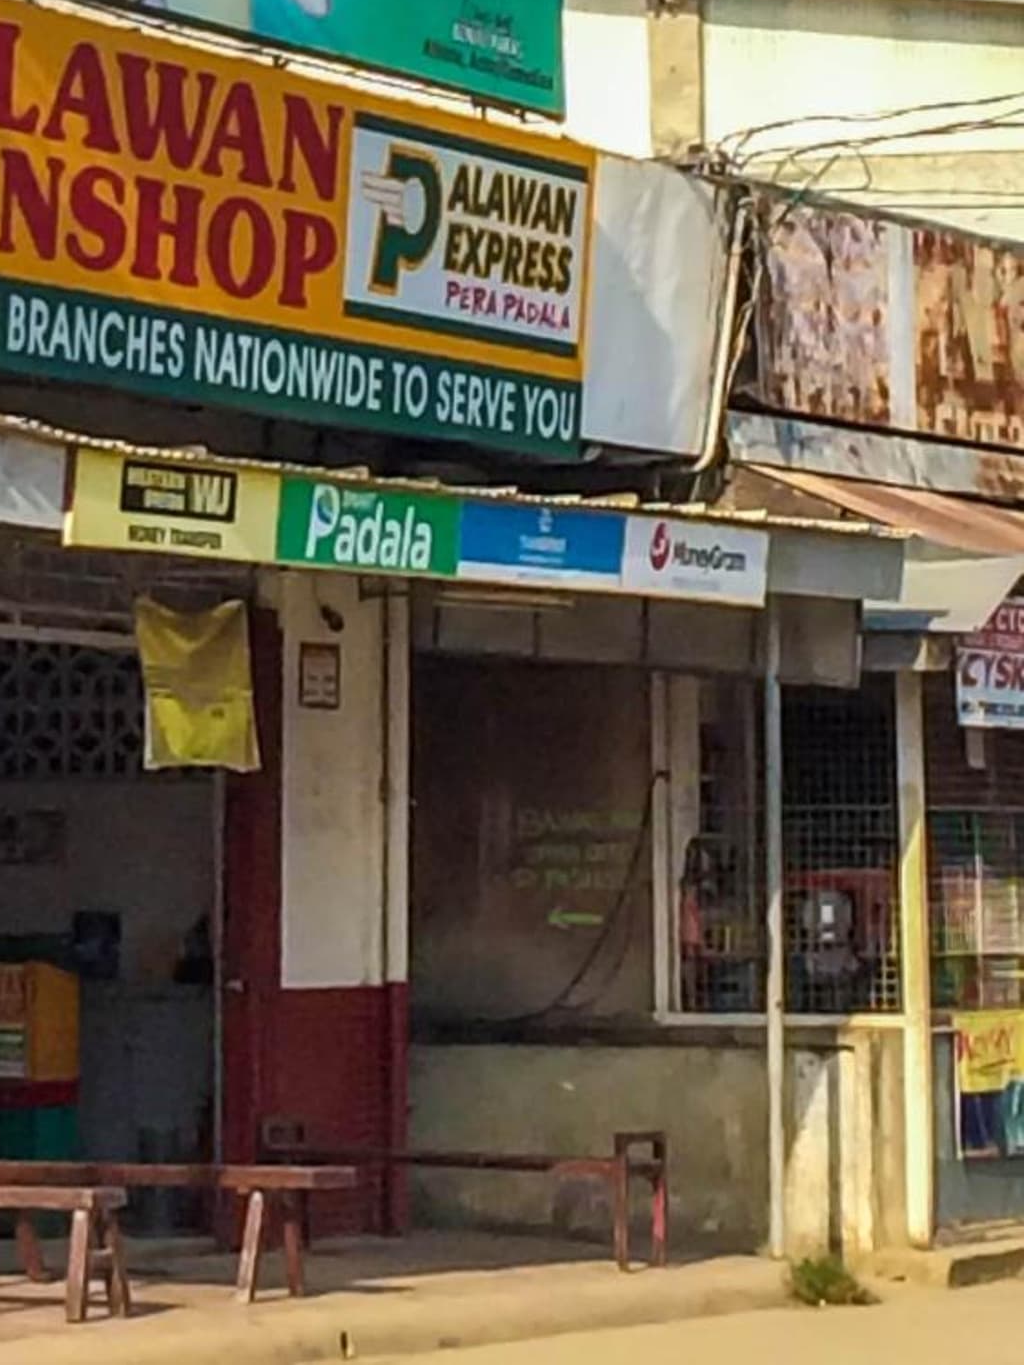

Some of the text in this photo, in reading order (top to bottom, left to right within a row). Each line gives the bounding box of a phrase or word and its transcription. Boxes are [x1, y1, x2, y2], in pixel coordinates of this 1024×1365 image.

[443, 223, 573, 294] EXPRESS
[445, 280, 571, 329] PERA PADALA
[7, 295, 576, 440] BRANCHES NATIONWIDE TO SERVE YOU
[305, 484, 432, 570] Padala
